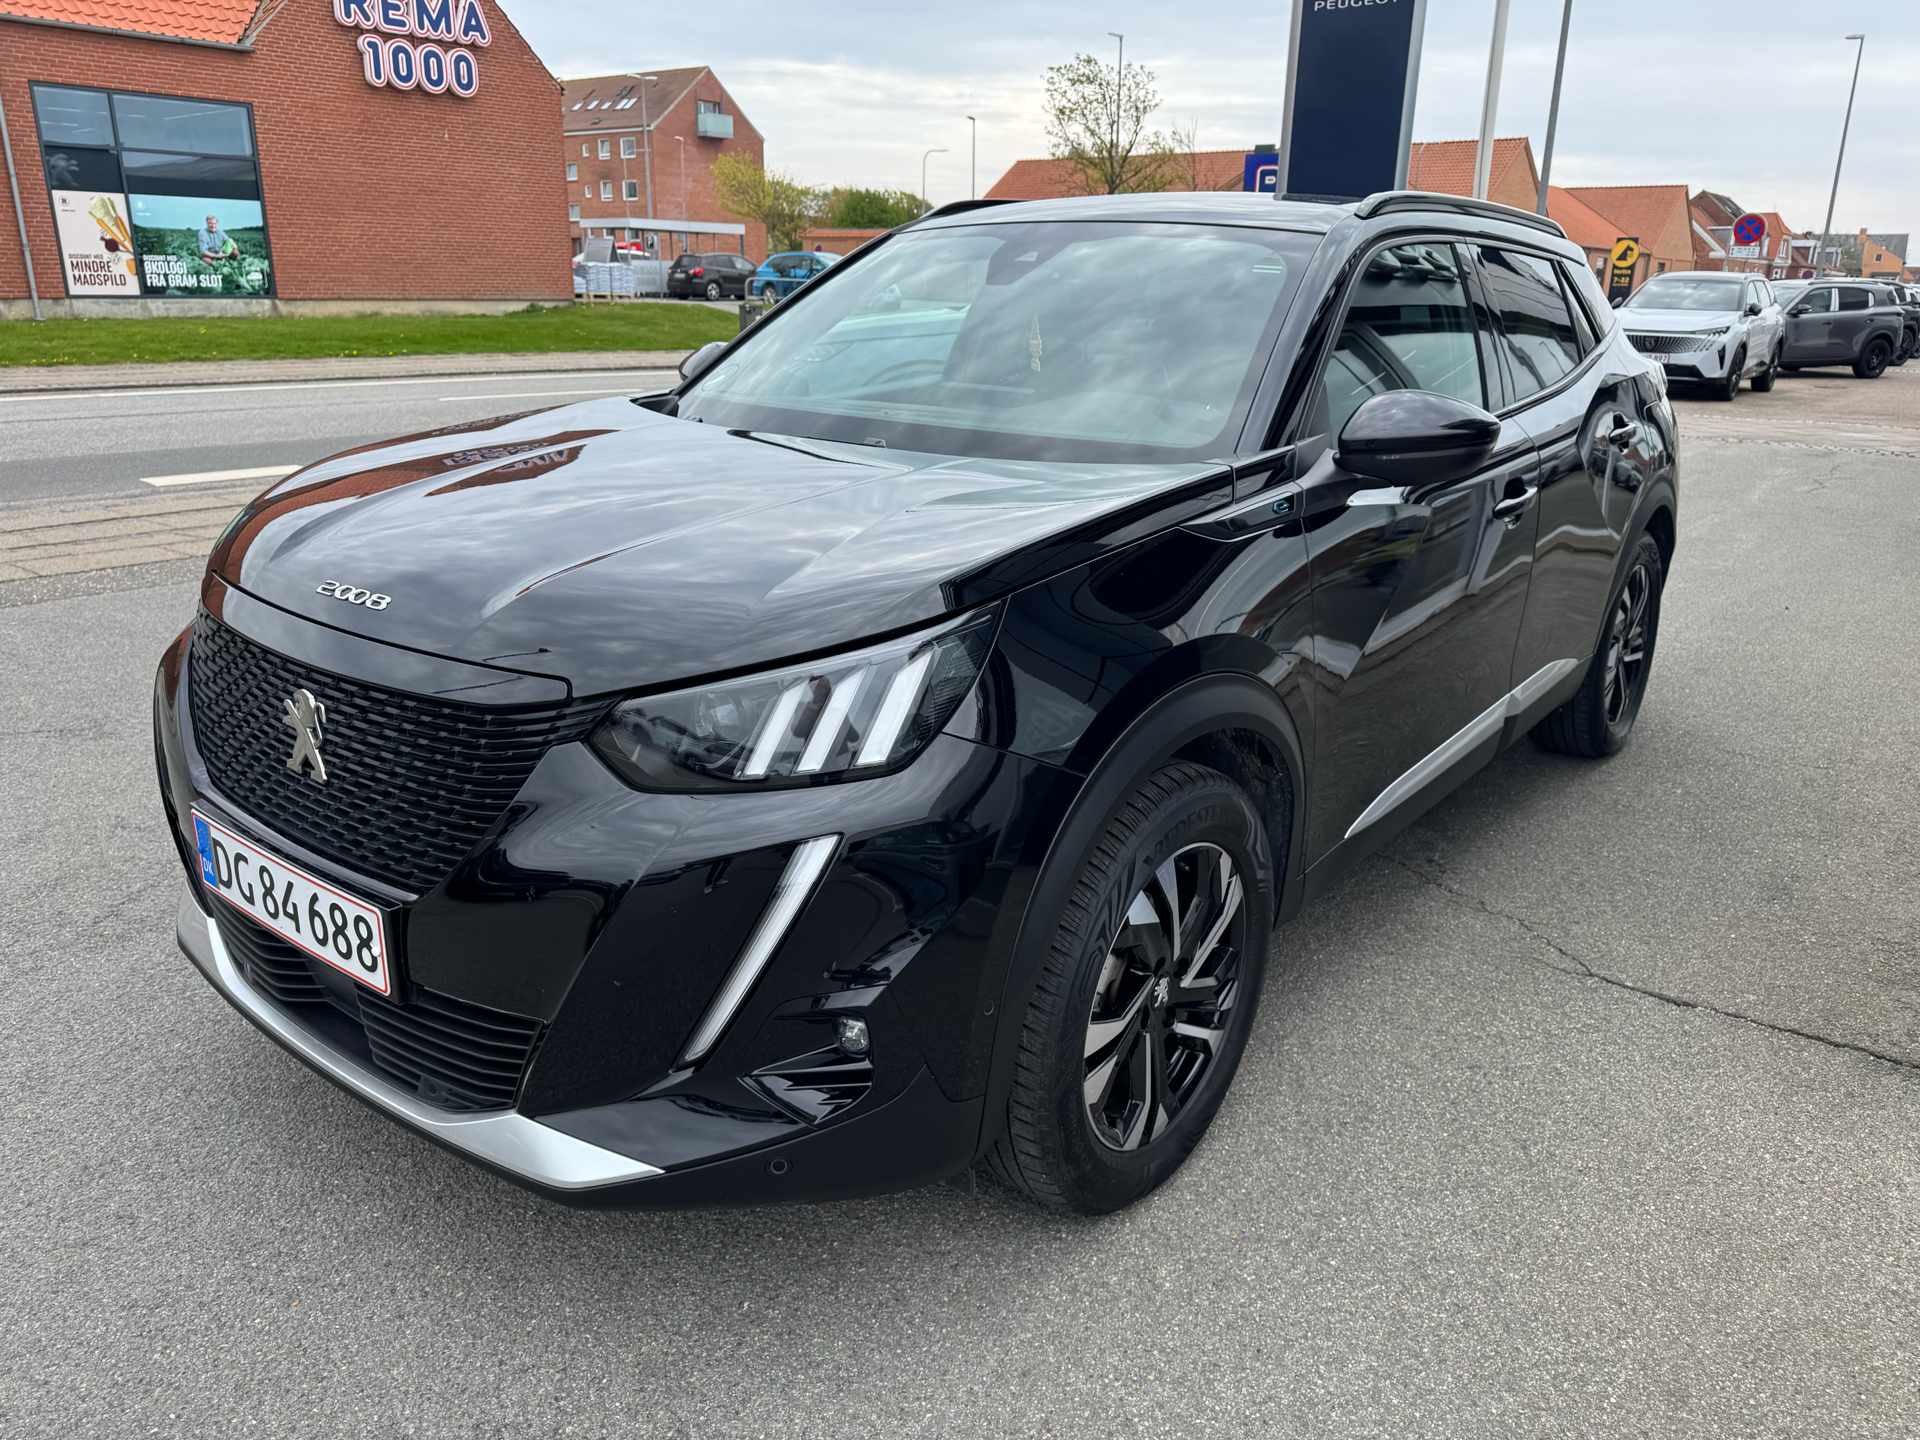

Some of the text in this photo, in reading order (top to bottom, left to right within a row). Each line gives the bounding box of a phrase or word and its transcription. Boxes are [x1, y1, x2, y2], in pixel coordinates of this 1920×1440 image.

[1314, 0, 1397, 11] PEUGE
[333, 0, 491, 46] REMA
[357, 34, 479, 97] 1000
[70, 260, 113, 273] MINDRE
[143, 261, 188, 274] ØKOLOGI
[72, 273, 127, 286] MADSPILD
[146, 274, 223, 287] FRA GRAM SLOT
[316, 579, 392, 611] 2008
[203, 857, 214, 876] DK
